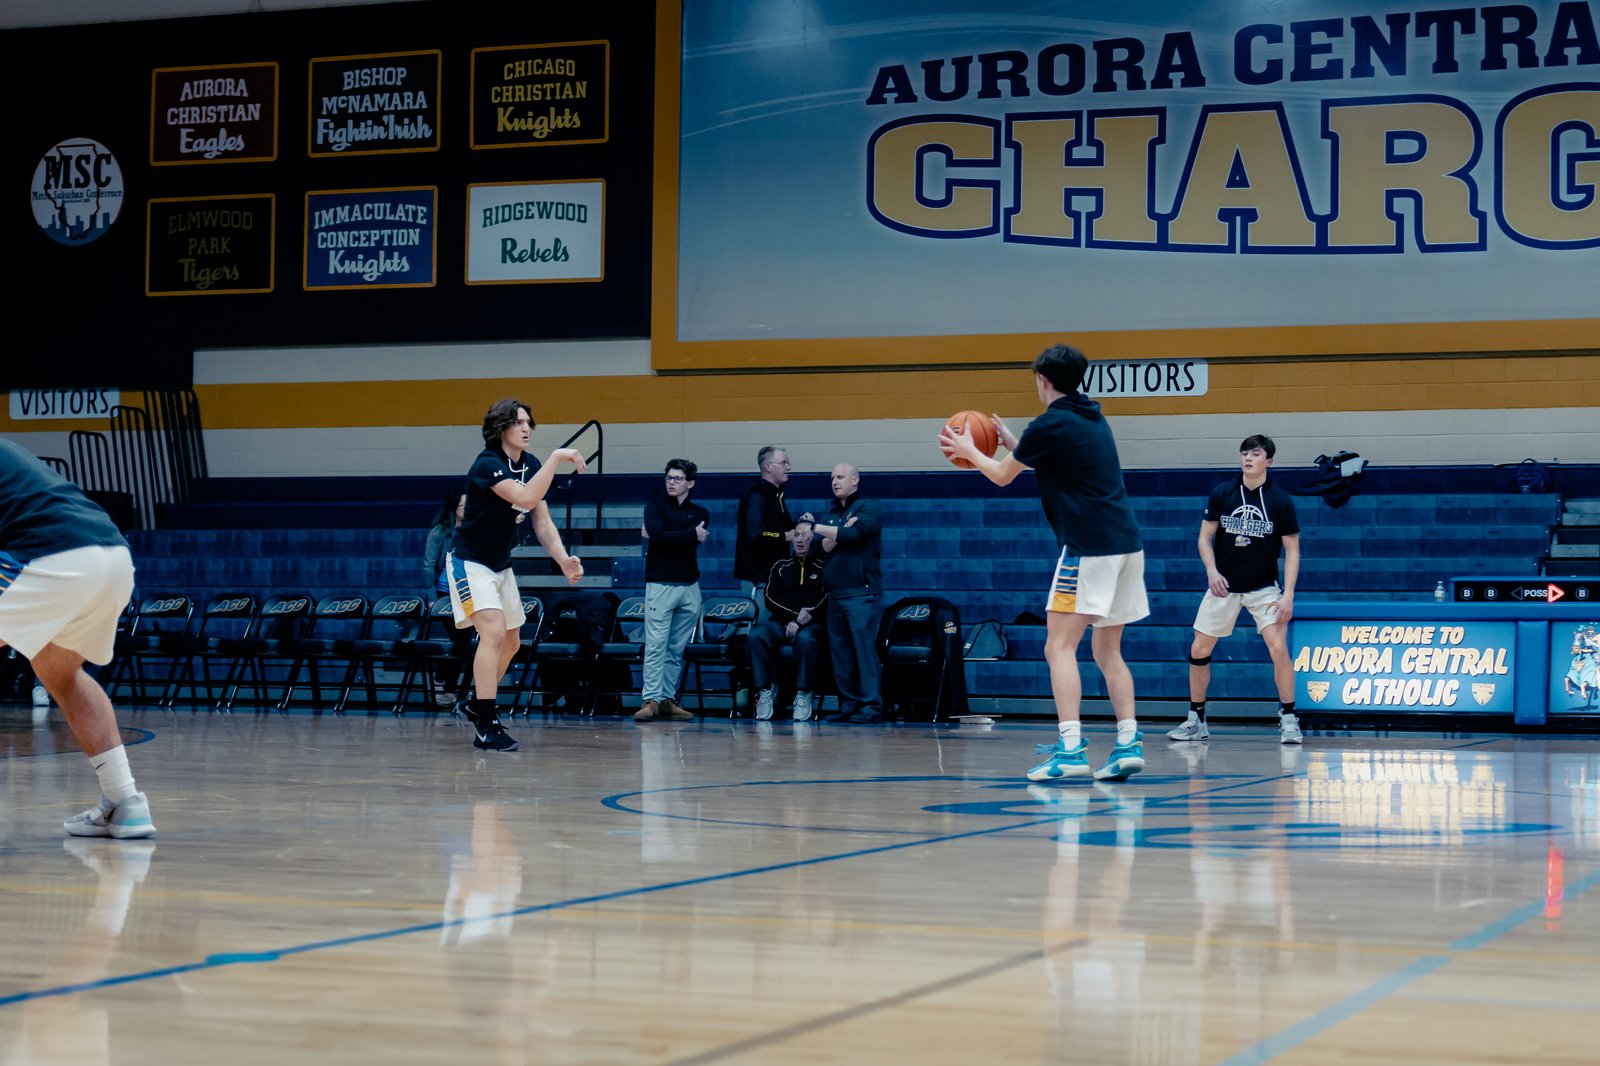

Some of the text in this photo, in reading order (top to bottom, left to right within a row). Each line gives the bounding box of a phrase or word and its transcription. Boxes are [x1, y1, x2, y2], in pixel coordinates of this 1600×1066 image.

[866, 0, 1600, 106] AURORA CENTRA
[343, 67, 407, 90] BISHOP
[504, 58, 576, 81] CHICAGO
[180, 78, 249, 102] AURORA
[491, 81, 588, 104] CHRISTIAN
[167, 103, 262, 126] CHRISTIAN
[497, 107, 582, 139] Knights
[180, 128, 245, 159] Eagles
[44, 153, 112, 190] MSC
[866, 82, 1600, 255] CHARG
[167, 210, 253, 235] ELMWOOD
[314, 203, 427, 230] IMMACULATE
[482, 201, 588, 229] RIDGEWOOD
[187, 236, 232, 256] PARK
[317, 228, 420, 249] CONCEPTION
[500, 237, 570, 265] Rebels
[177, 257, 240, 290] Tigers
[328, 250, 410, 282] Knights
[1082, 361, 1195, 393] VISITORS
[19, 388, 110, 416] VISITORS
[1463, 589, 1471, 598] B
[1487, 588, 1495, 597] B
[1524, 589, 1548, 598] POSS
[1578, 589, 1586, 598] B
[146, 598, 186, 612] ACC
[212, 598, 250, 612] ACC
[269, 599, 307, 613] ACC
[323, 599, 362, 613] ACC
[379, 600, 419, 614] ACC
[707, 601, 749, 616] ACC
[900, 604, 931, 618] AC
[1341, 626, 1465, 645] WELCOME TO
[1293, 646, 1508, 677] AURORA CENTRAL
[1342, 678, 1460, 706] CATHOLIC
